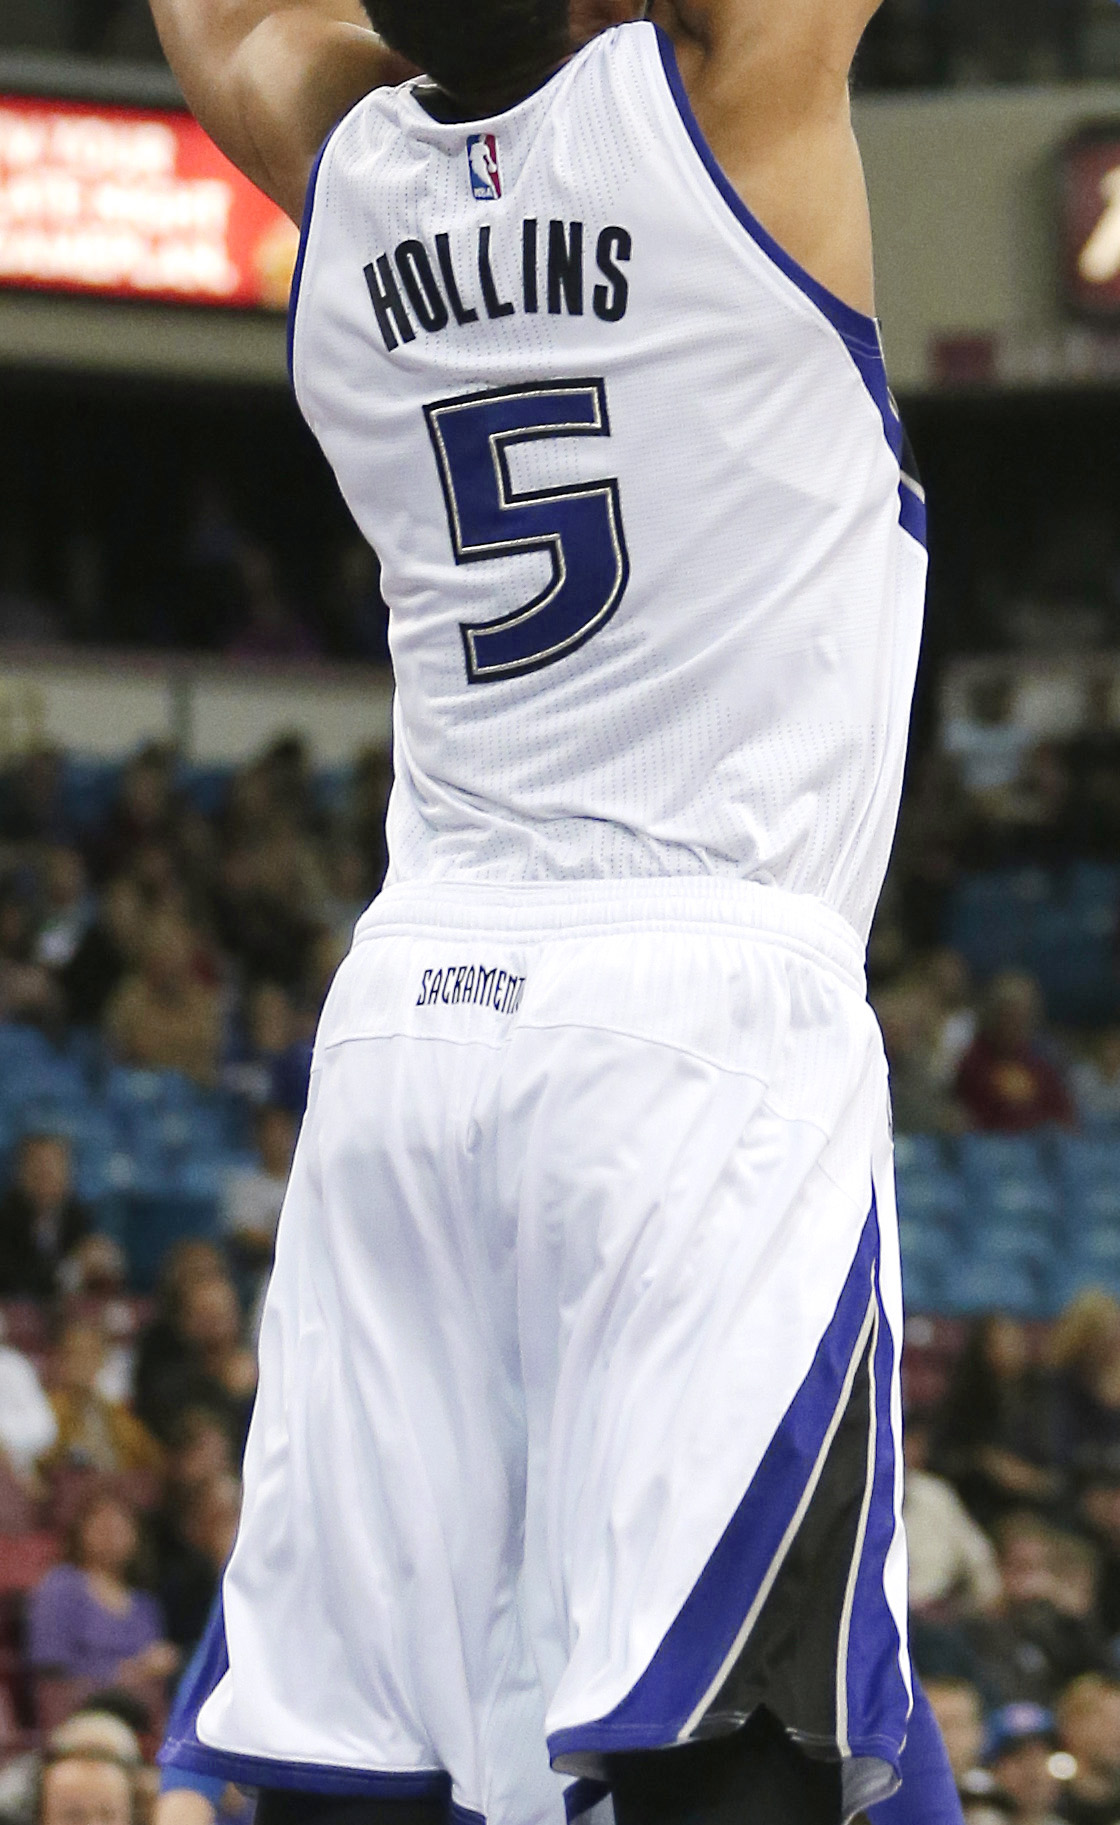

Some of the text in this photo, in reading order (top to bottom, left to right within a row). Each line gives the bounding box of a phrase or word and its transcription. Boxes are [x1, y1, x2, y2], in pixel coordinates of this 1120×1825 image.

[363, 218, 631, 352] HOLLINS
[423, 377, 631, 685] 5
[416, 964, 526, 1014] SACRAMENT
